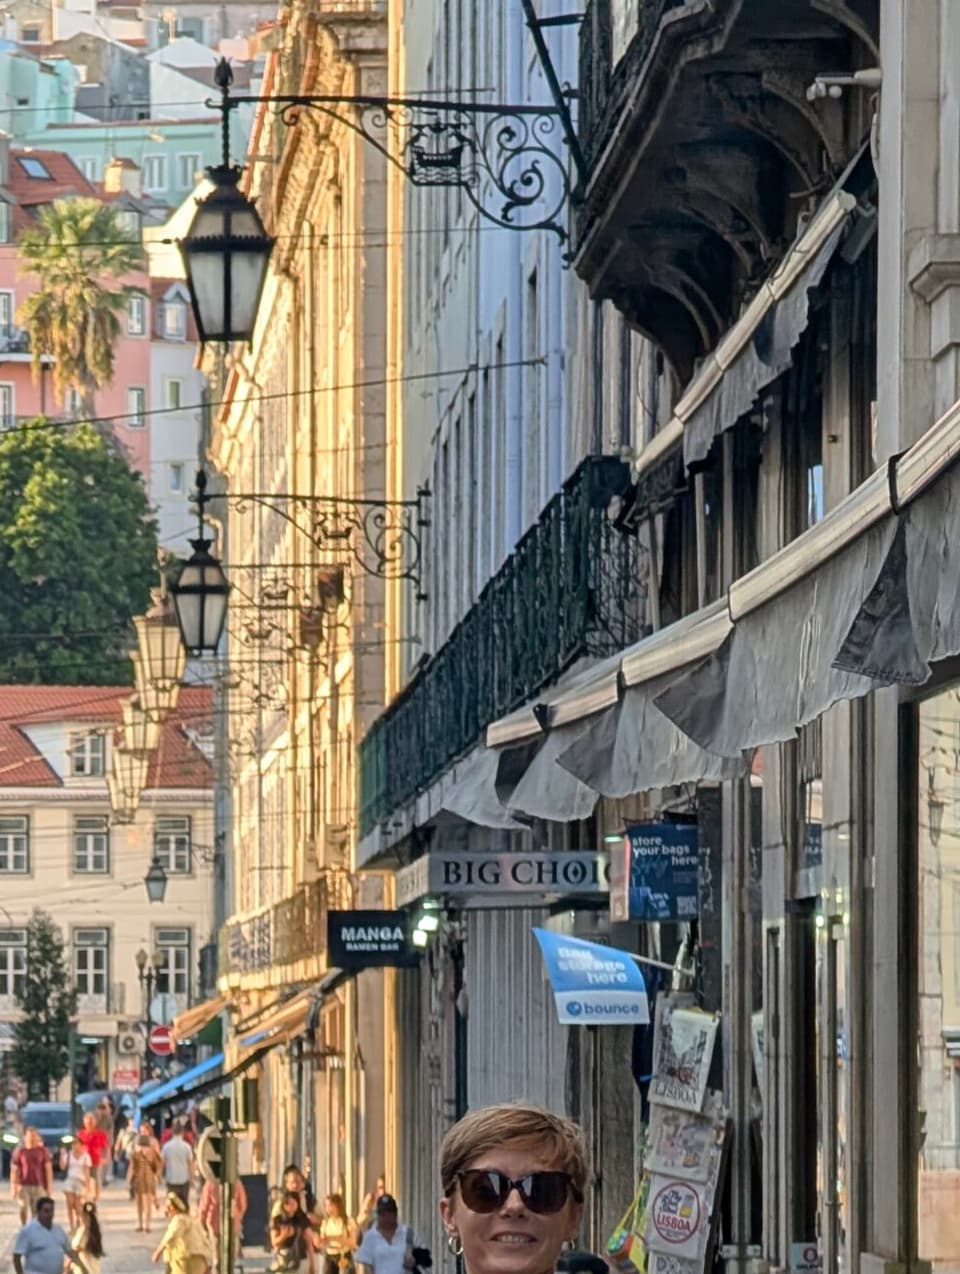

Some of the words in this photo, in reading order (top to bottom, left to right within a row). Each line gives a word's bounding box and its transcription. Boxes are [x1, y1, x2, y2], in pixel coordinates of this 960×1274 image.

[632, 836, 662, 846] store
[633, 846, 659, 859] your
[661, 844, 690, 855] bags
[671, 855, 698, 866] here
[443, 860, 500, 885] BIG
[341, 926, 404, 941] MANGA
[345, 942, 378, 951] RAMEN
[380, 942, 399, 951] BAR
[586, 971, 627, 984] here
[584, 1001, 639, 1015] bounce
[656, 1213, 691, 1233] LISBOA
